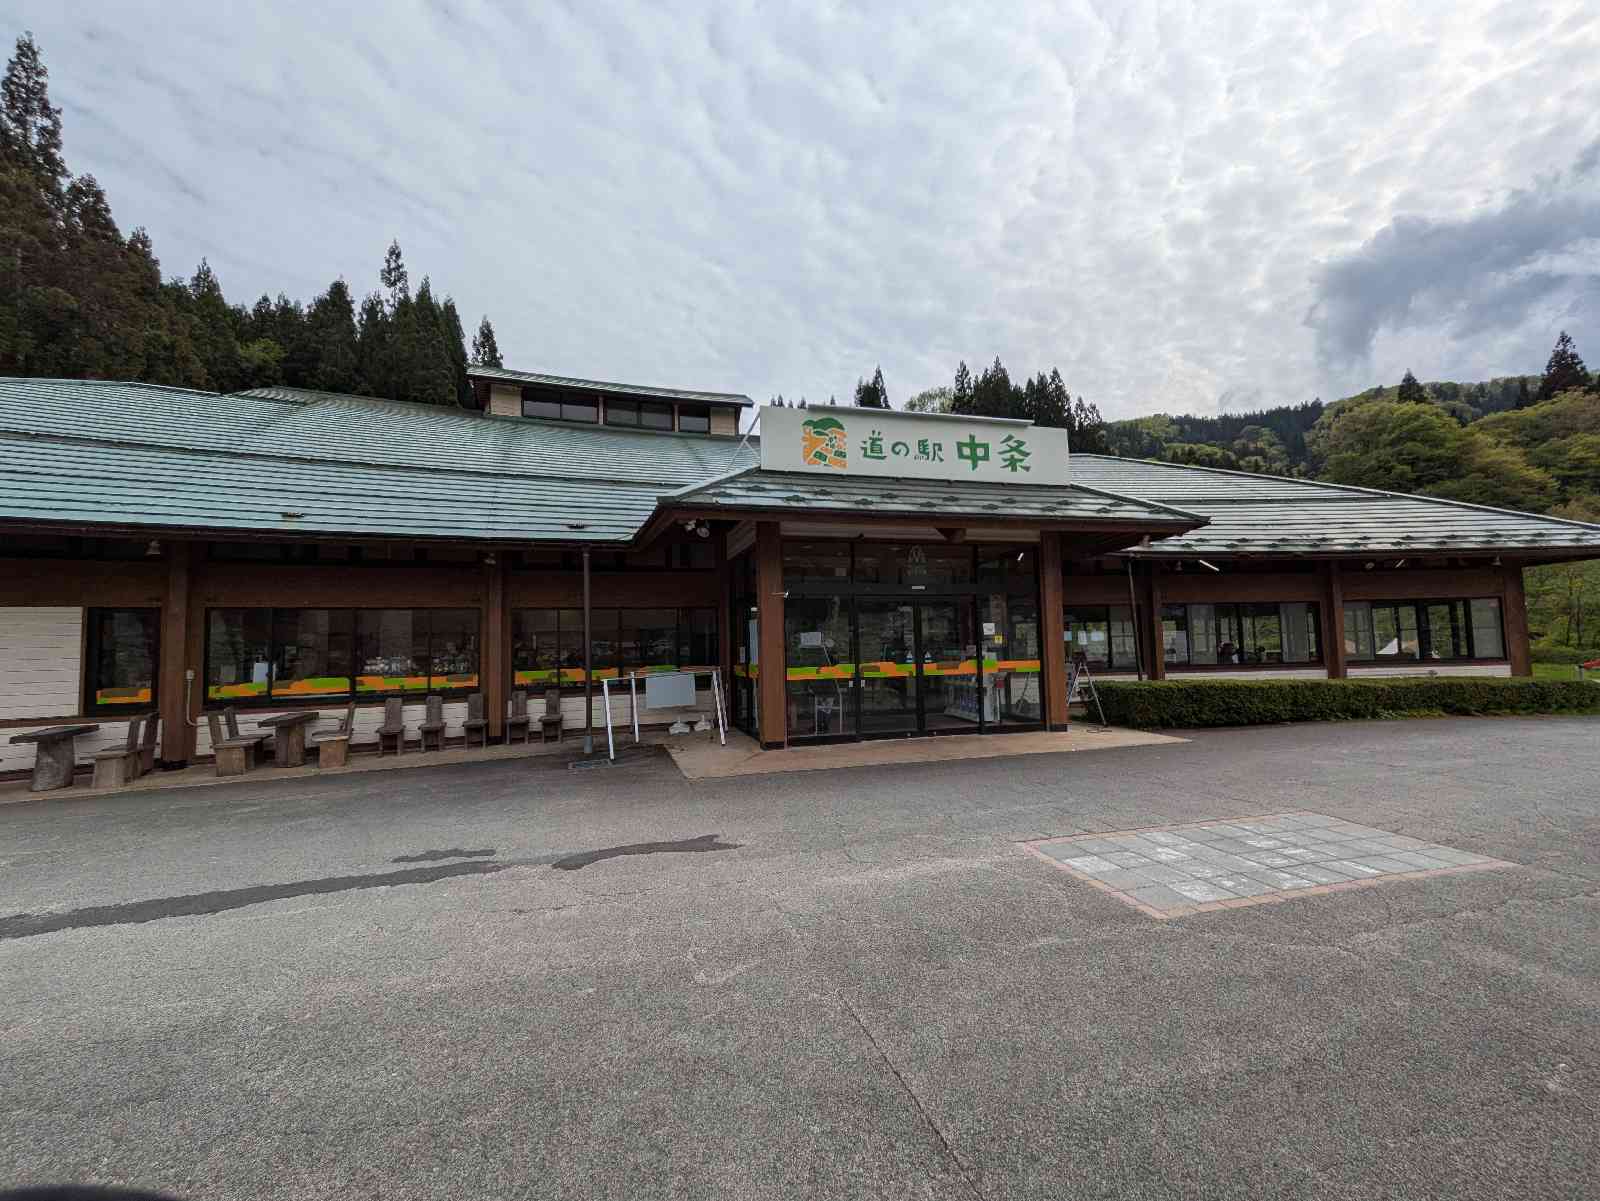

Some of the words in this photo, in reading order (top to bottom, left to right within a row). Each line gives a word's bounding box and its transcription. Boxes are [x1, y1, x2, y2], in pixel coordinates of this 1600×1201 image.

[860, 430, 945, 463] 道の駅
[956, 433, 1031, 473] 中条
